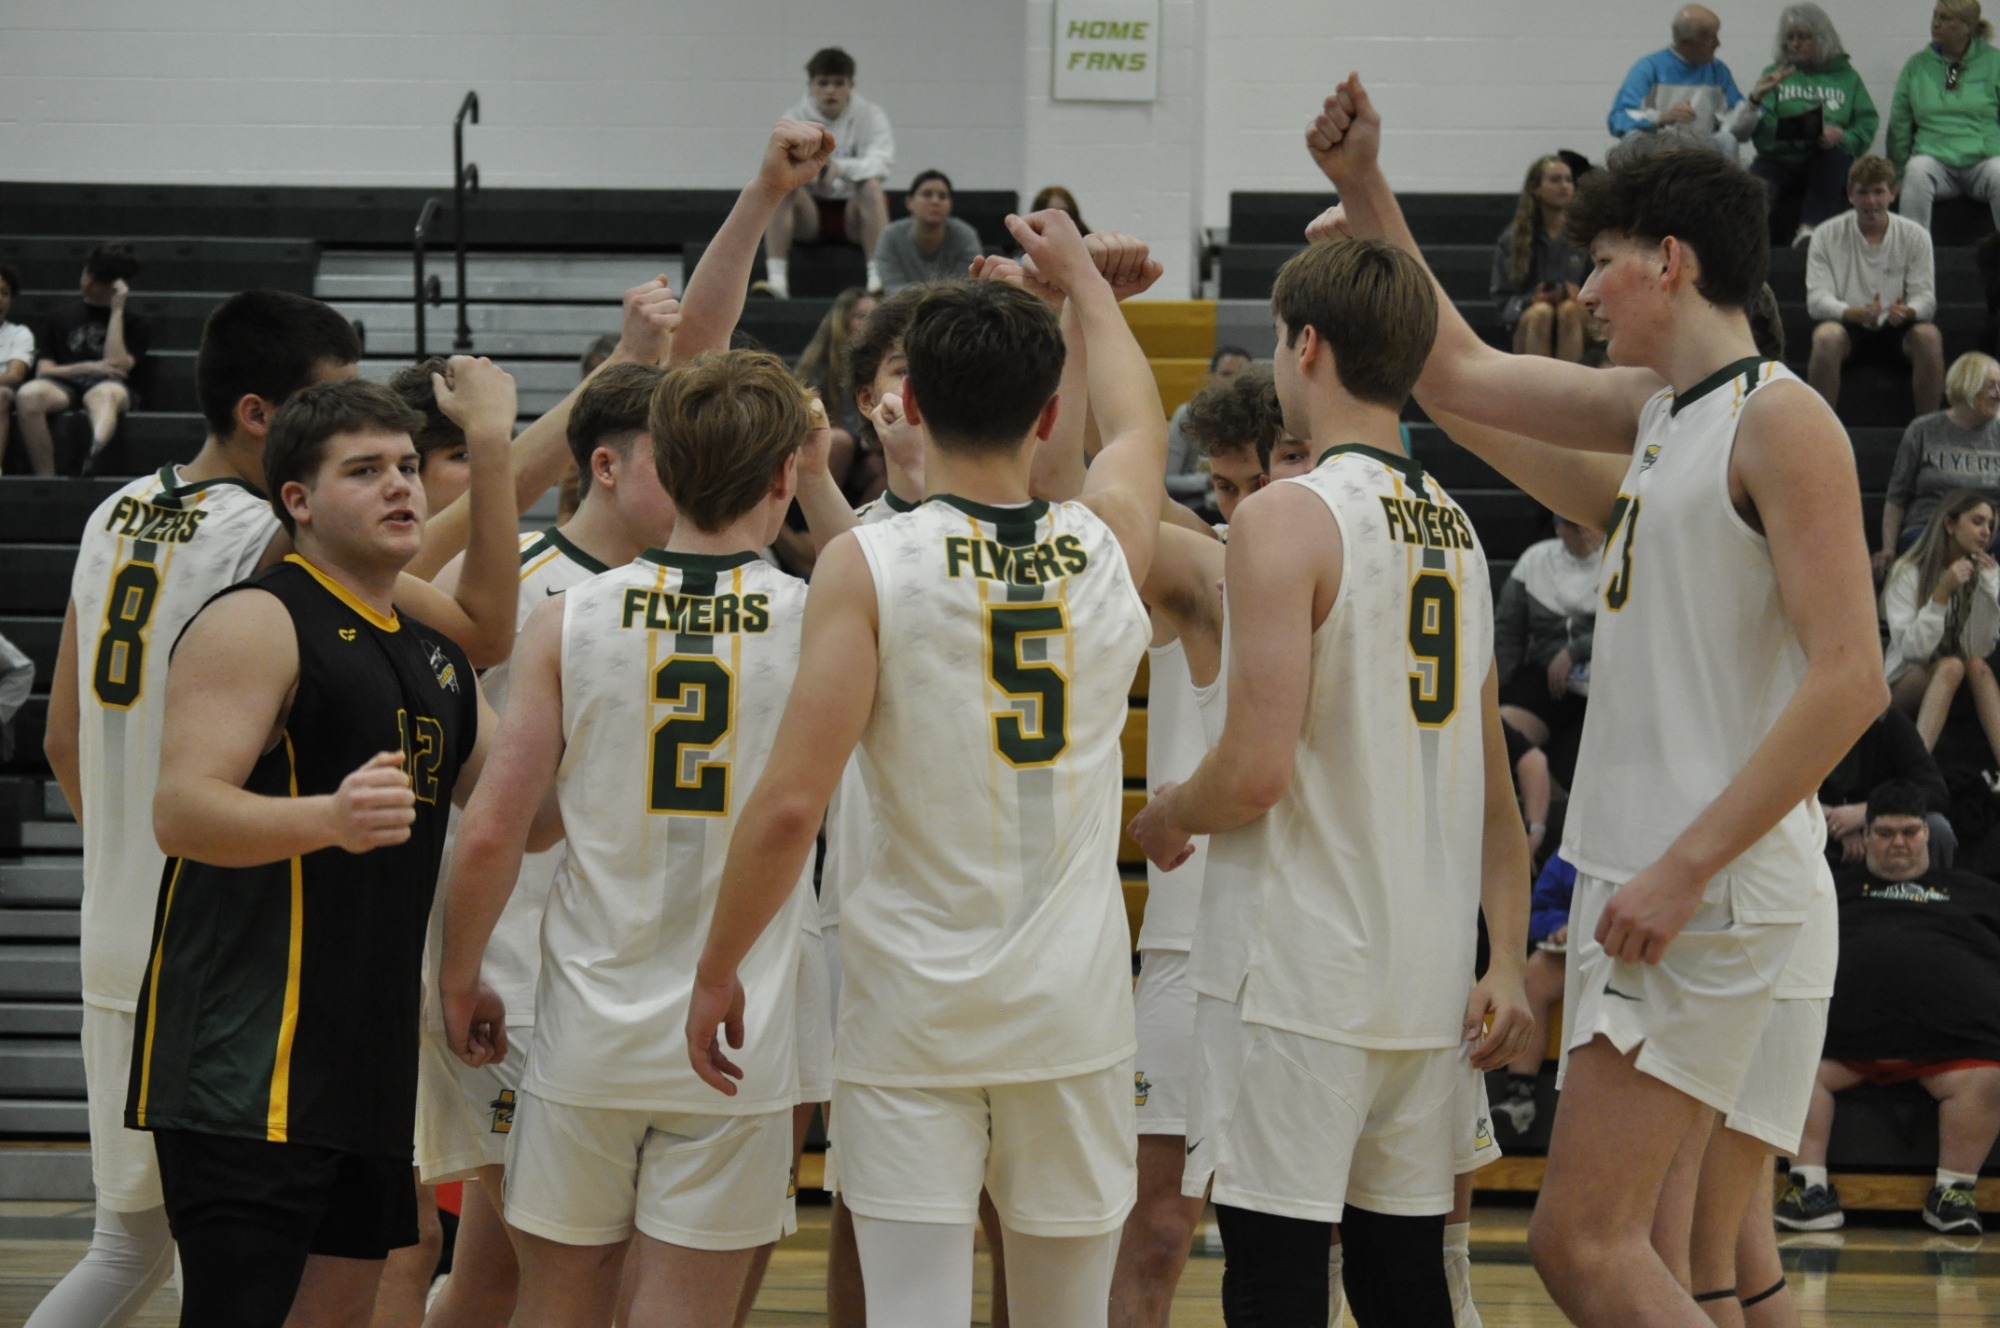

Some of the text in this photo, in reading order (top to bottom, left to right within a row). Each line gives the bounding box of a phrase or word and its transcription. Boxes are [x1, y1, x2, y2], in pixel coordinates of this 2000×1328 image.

[1066, 20, 1151, 40] HOME
[1066, 52, 1147, 71] FANS
[105, 495, 208, 543] FLYERS
[1379, 495, 1474, 551] FLYERS
[944, 533, 1089, 587] FLYERS
[92, 559, 163, 711] 8
[621, 587, 770, 635] FLYERS
[1407, 568, 1460, 729] 9
[982, 600, 1072, 770] 5
[397, 708, 444, 806] 12
[646, 653, 737, 817] 2
